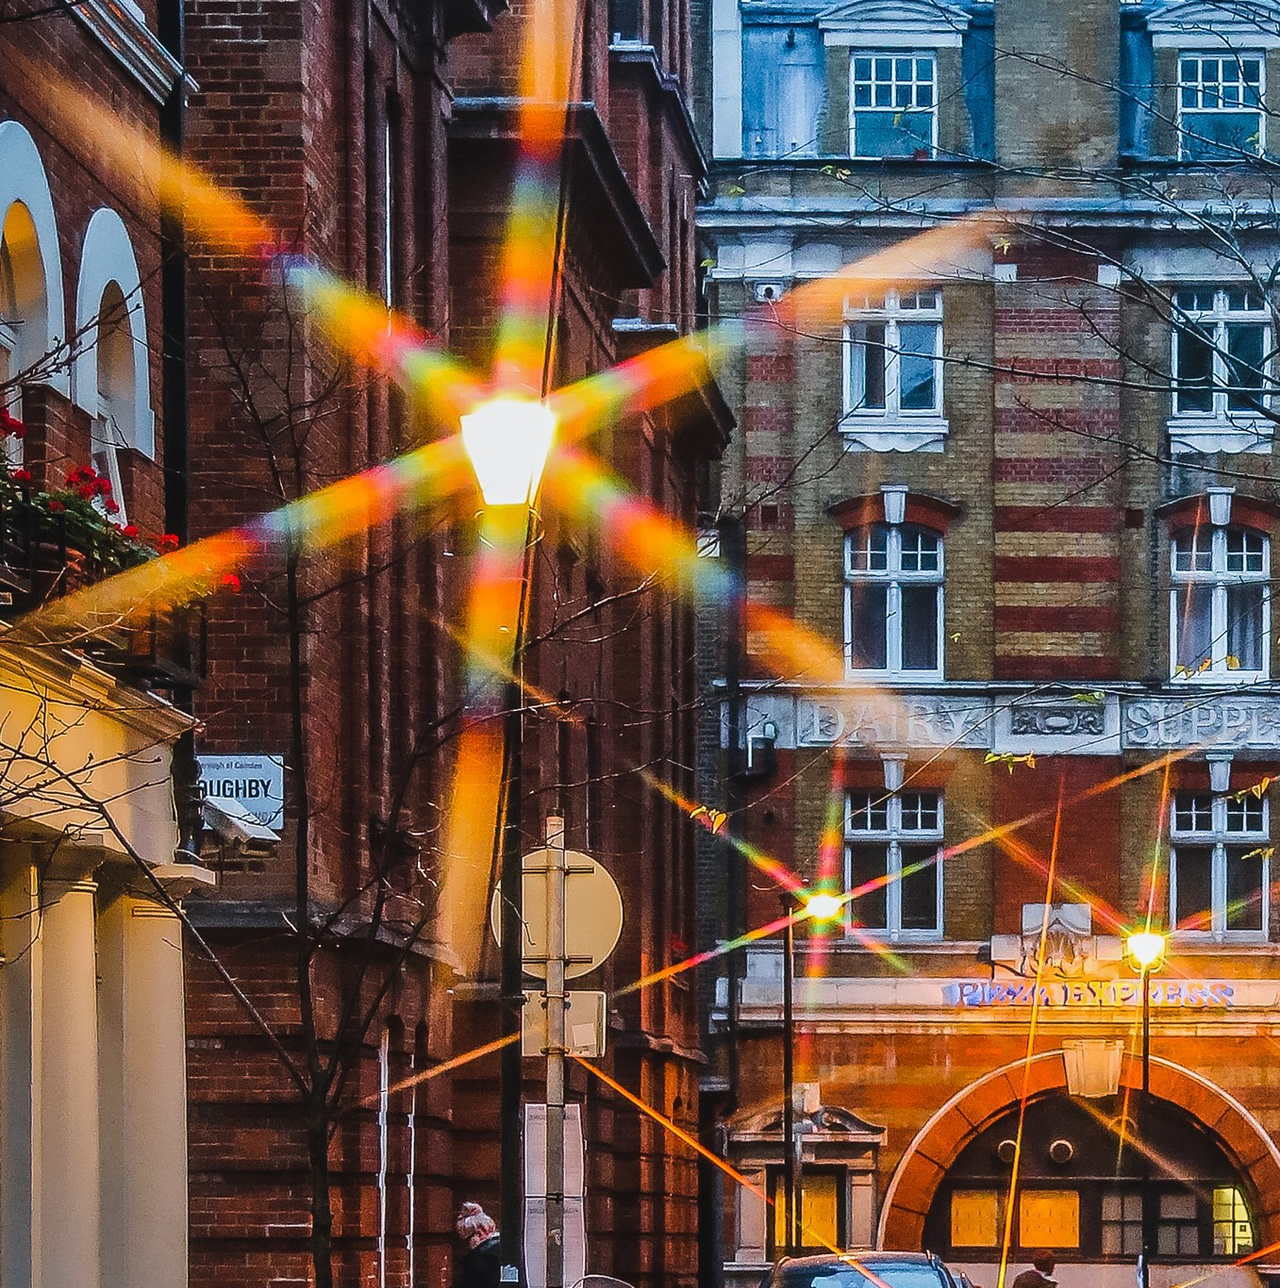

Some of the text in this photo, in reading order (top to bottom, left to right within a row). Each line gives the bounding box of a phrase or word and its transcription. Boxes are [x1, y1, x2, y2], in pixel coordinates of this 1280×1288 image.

[809, 703, 969, 743] DAIRY
[956, 981, 1233, 1007] PIZZA EXPRESS
